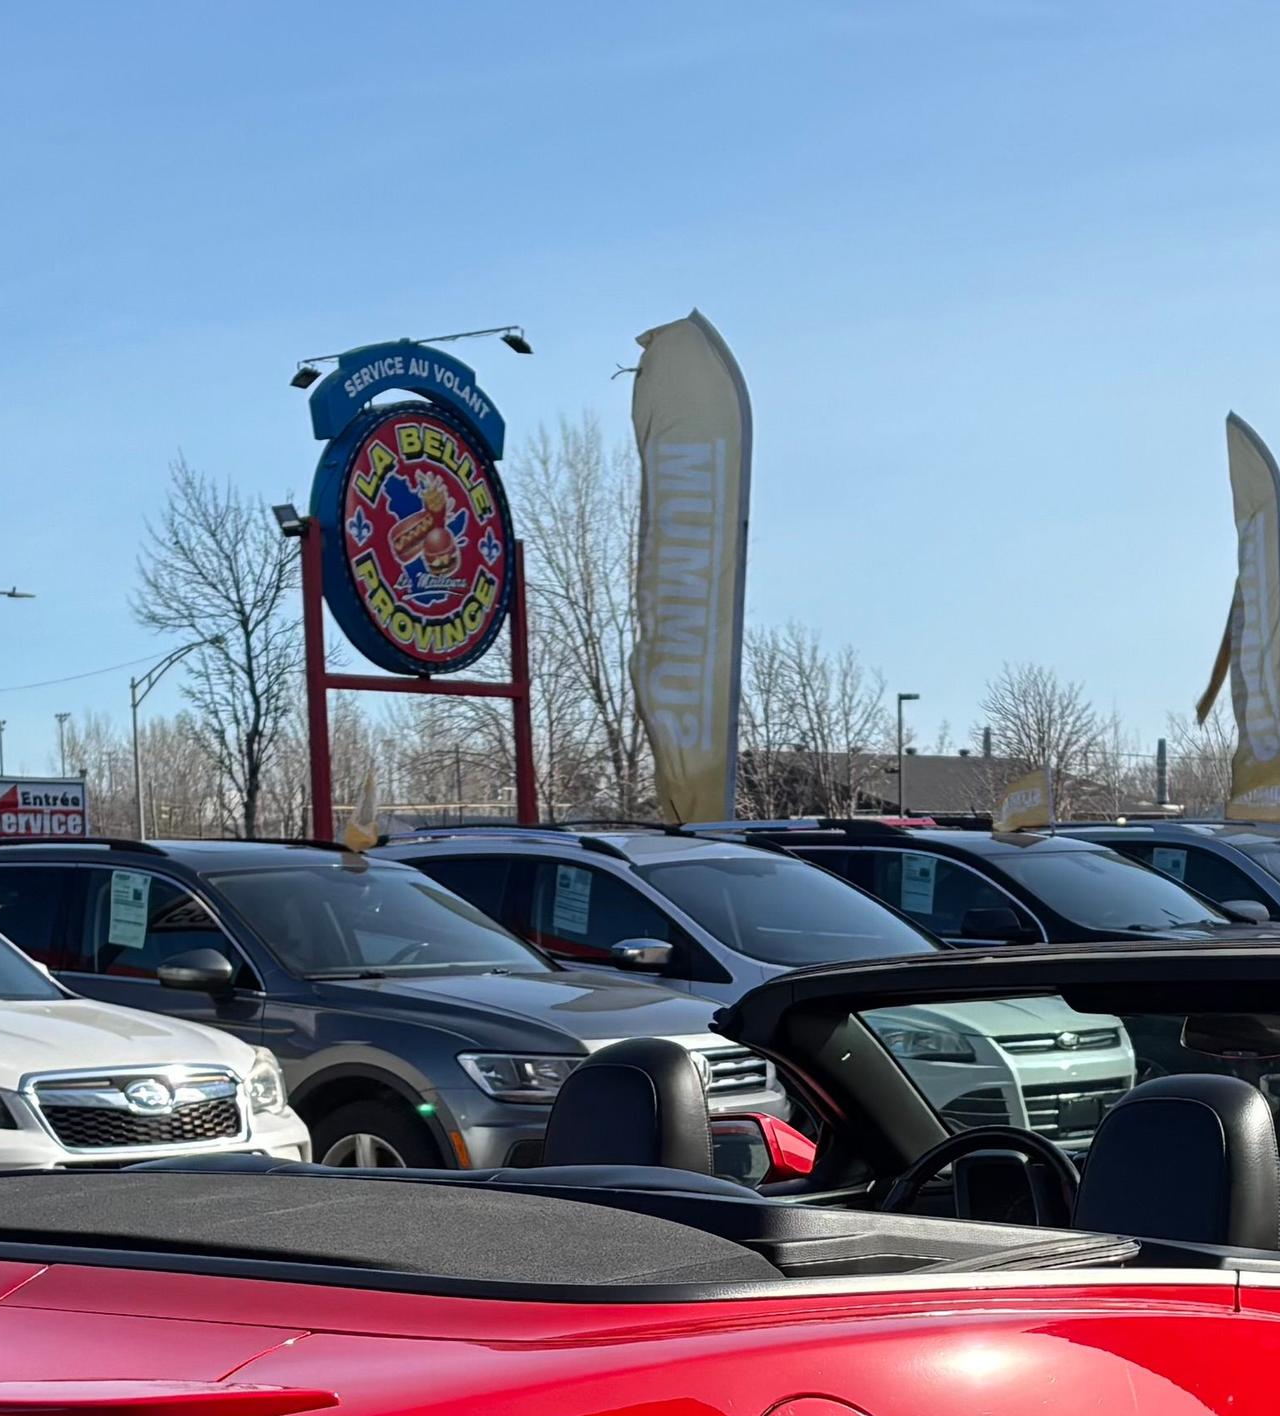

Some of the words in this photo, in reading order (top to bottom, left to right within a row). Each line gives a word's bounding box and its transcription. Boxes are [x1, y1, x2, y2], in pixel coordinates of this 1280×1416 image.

[343, 355, 405, 399] SERVICE
[408, 358, 430, 378] AU
[433, 364, 489, 419] VOLANT
[354, 439, 396, 504] LA
[395, 423, 494, 523] BELLE
[353, 551, 497, 652] PROVINCE
[21, 790, 80, 807] Entrée
